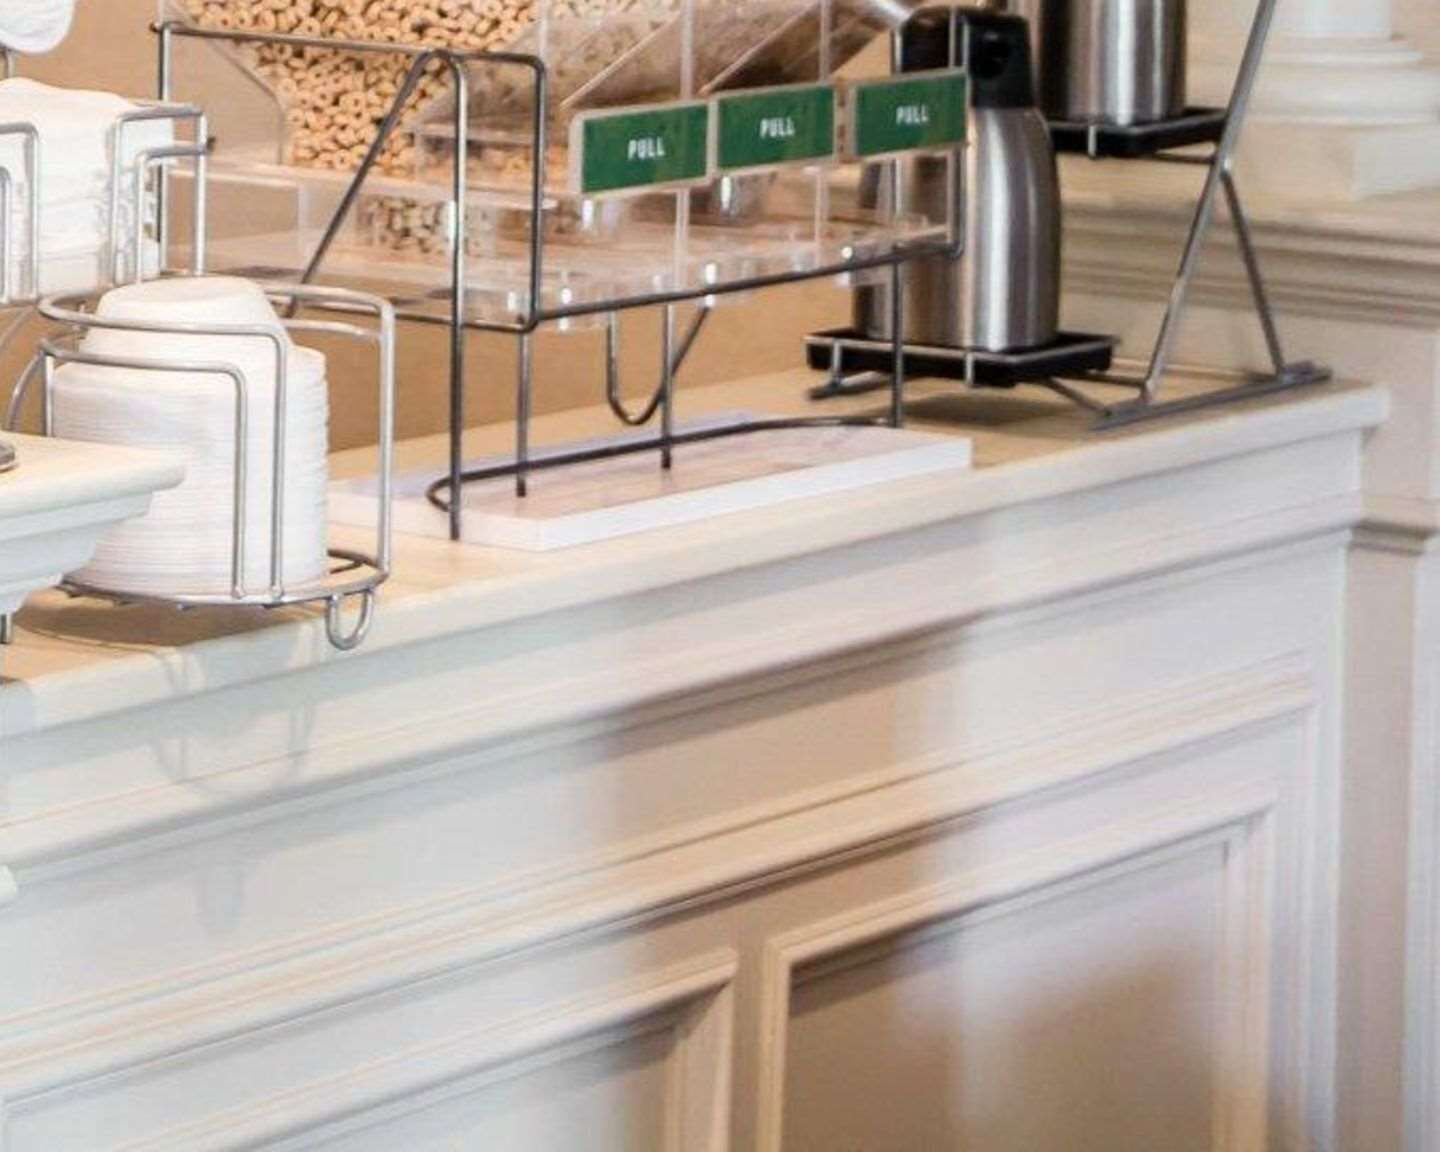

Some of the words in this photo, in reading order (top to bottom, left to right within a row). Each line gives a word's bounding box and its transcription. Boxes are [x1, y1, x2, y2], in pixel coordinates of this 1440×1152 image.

[895, 103, 930, 125] PULL
[760, 116, 796, 139] PULL
[627, 135, 666, 161] PULL
